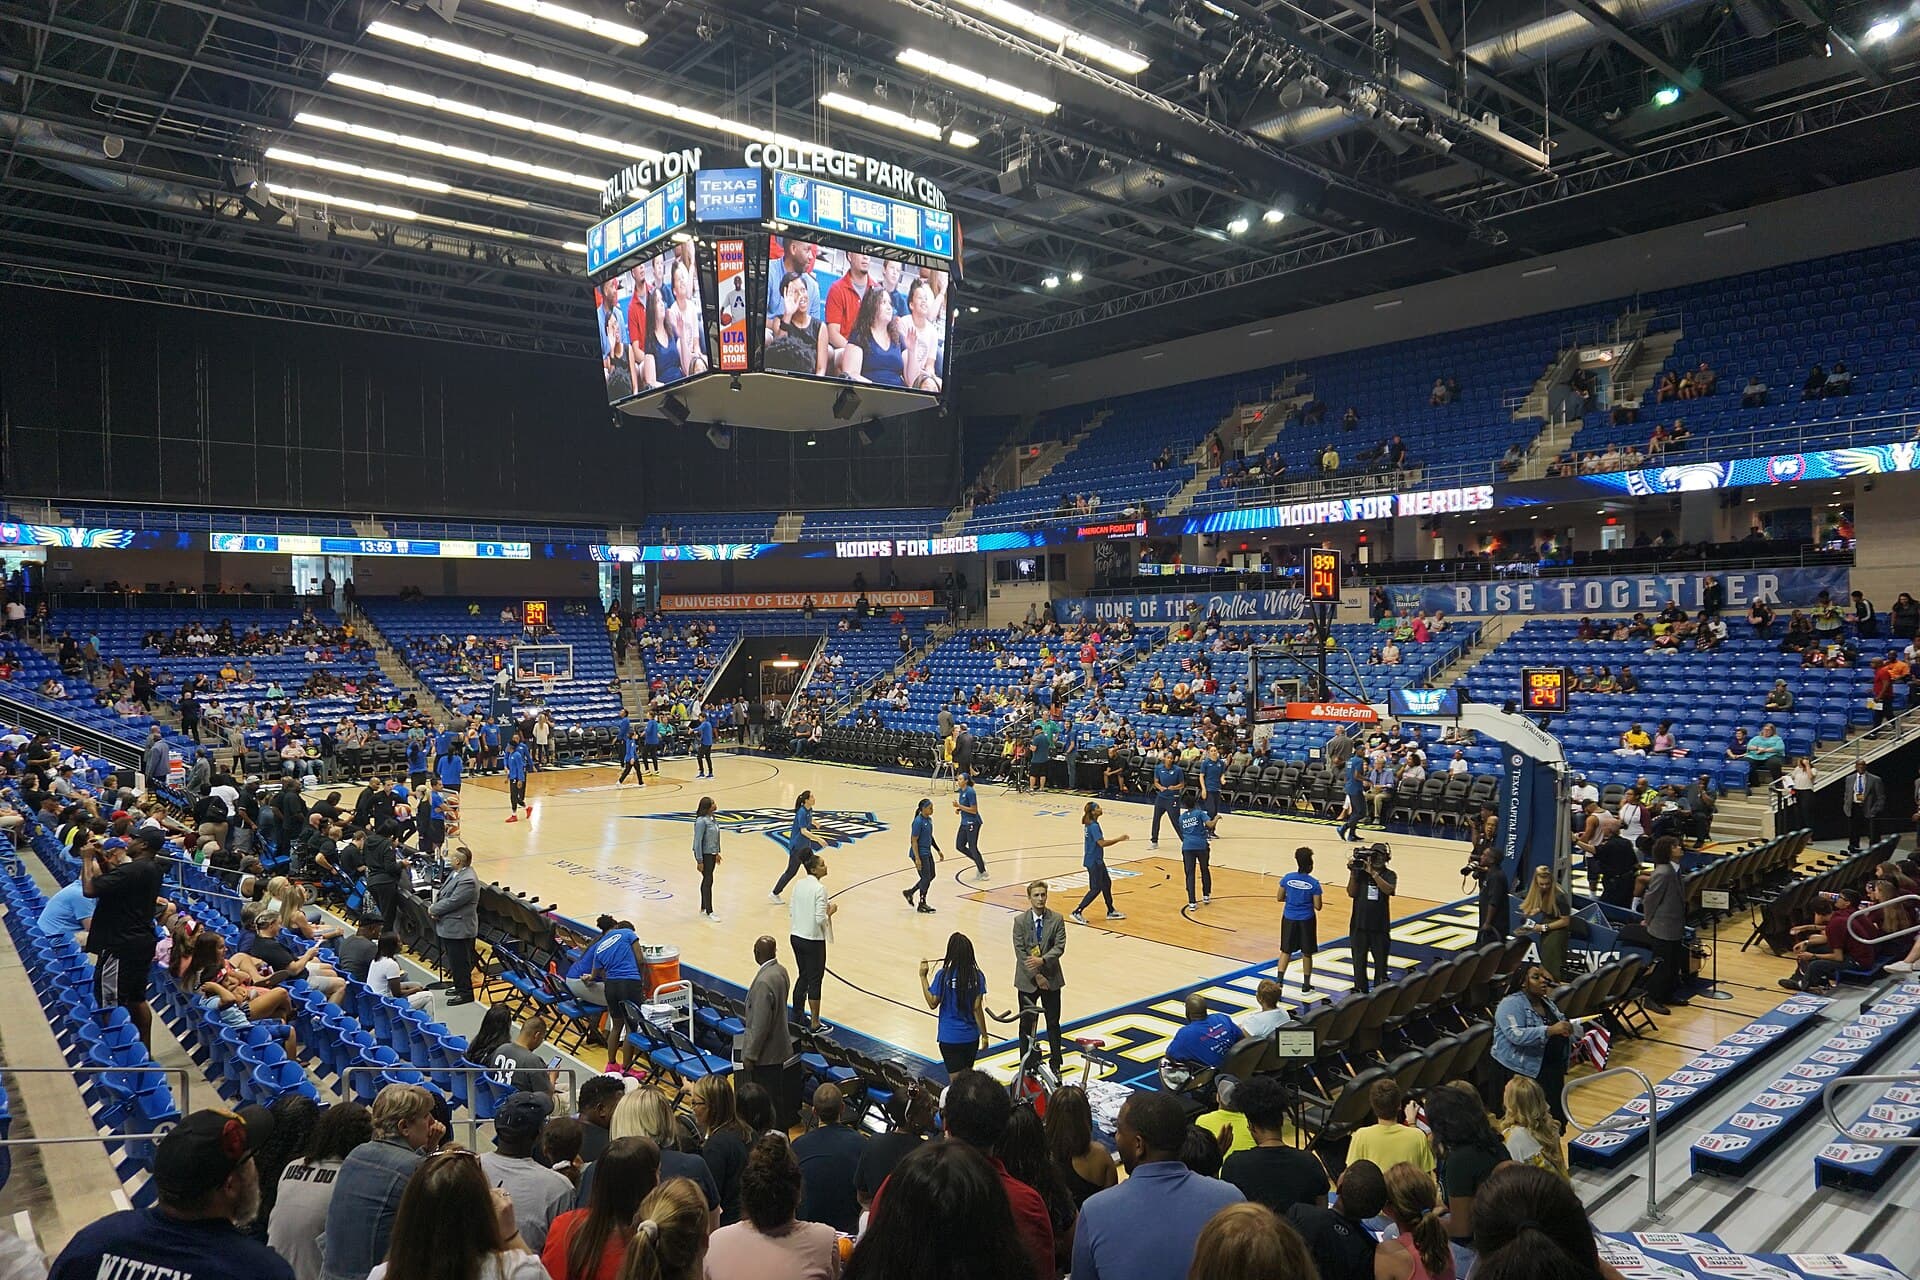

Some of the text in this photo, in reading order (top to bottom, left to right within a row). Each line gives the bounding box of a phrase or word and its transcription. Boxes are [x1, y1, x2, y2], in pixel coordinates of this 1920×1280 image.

[744, 143, 857, 179] COLLEGE
[865, 156, 914, 196] PARK
[601, 147, 702, 210] ARLINGTON
[700, 179, 757, 191] TEXAS
[700, 194, 756, 205] TRUST
[673, 206, 680, 222] 0
[789, 200, 799, 217] 0
[720, 243, 743, 251] SHOW
[933, 234, 942, 250] 0
[720, 262, 743, 270] SPIRIT
[723, 331, 745, 344] UTA
[722, 344, 745, 353] BOOK
[723, 354, 746, 363] STORE
[1774, 459, 1798, 475] VS
[1278, 485, 1494, 526] HOOPS FOR HEROES
[1077, 526, 1109, 537] AMERICAN
[1109, 523, 1136, 533] FIDELITY
[255, 538, 265, 549] 0
[360, 541, 392, 553] 13:59
[486, 545, 495, 556] 0
[836, 535, 978, 558] HOOPS FOR HEROES
[1313, 555, 1335, 570] 13:59
[1314, 571, 1333, 596] 24
[675, 596, 750, 608] UNIVERSITY
[754, 596, 771, 606] OF
[821, 594, 838, 605] AT
[842, 593, 919, 605] ARINGTON
[1095, 601, 1133, 618] HOME
[1140, 600, 1157, 618] OF
[1206, 595, 1257, 619] Dallas
[1263, 590, 1306, 620] Wing
[1456, 583, 1534, 613] RISE
[527, 612, 543, 624] 24
[1534, 689, 1556, 705] 24
[1521, 720, 1551, 746] SPALDING
[1182, 816, 1197, 824] MAYO
[1505, 769, 1521, 858] TEXAS CAPITAL BANK
[283, 1165, 337, 1184] JUST DO
